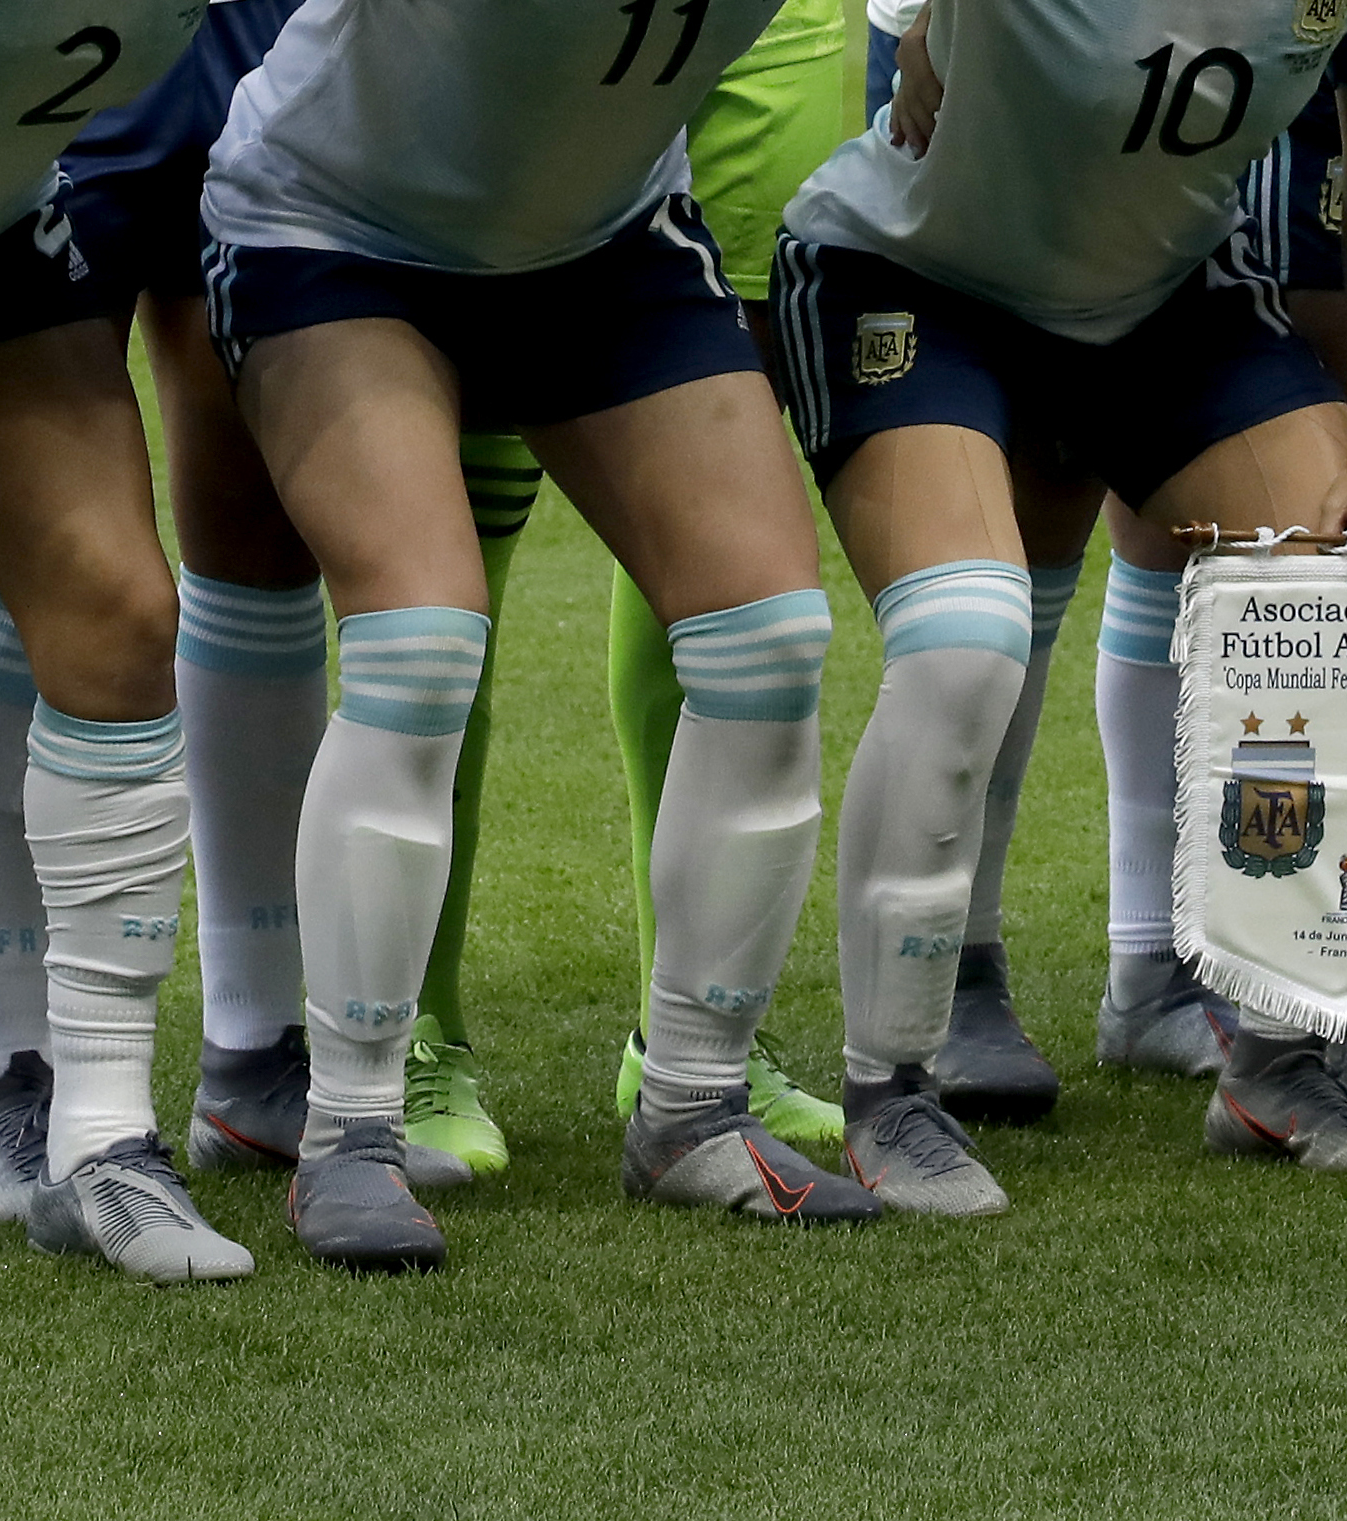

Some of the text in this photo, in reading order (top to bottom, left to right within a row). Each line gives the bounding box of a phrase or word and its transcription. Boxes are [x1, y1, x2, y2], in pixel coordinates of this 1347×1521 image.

[16, 24, 122, 126] 2
[1121, 43, 1254, 157] 10
[1221, 633, 1323, 659] Fútbol
[1267, 666, 1327, 691] Mundial
[1293, 930, 1305, 940] 14
[1309, 930, 1322, 940] de
